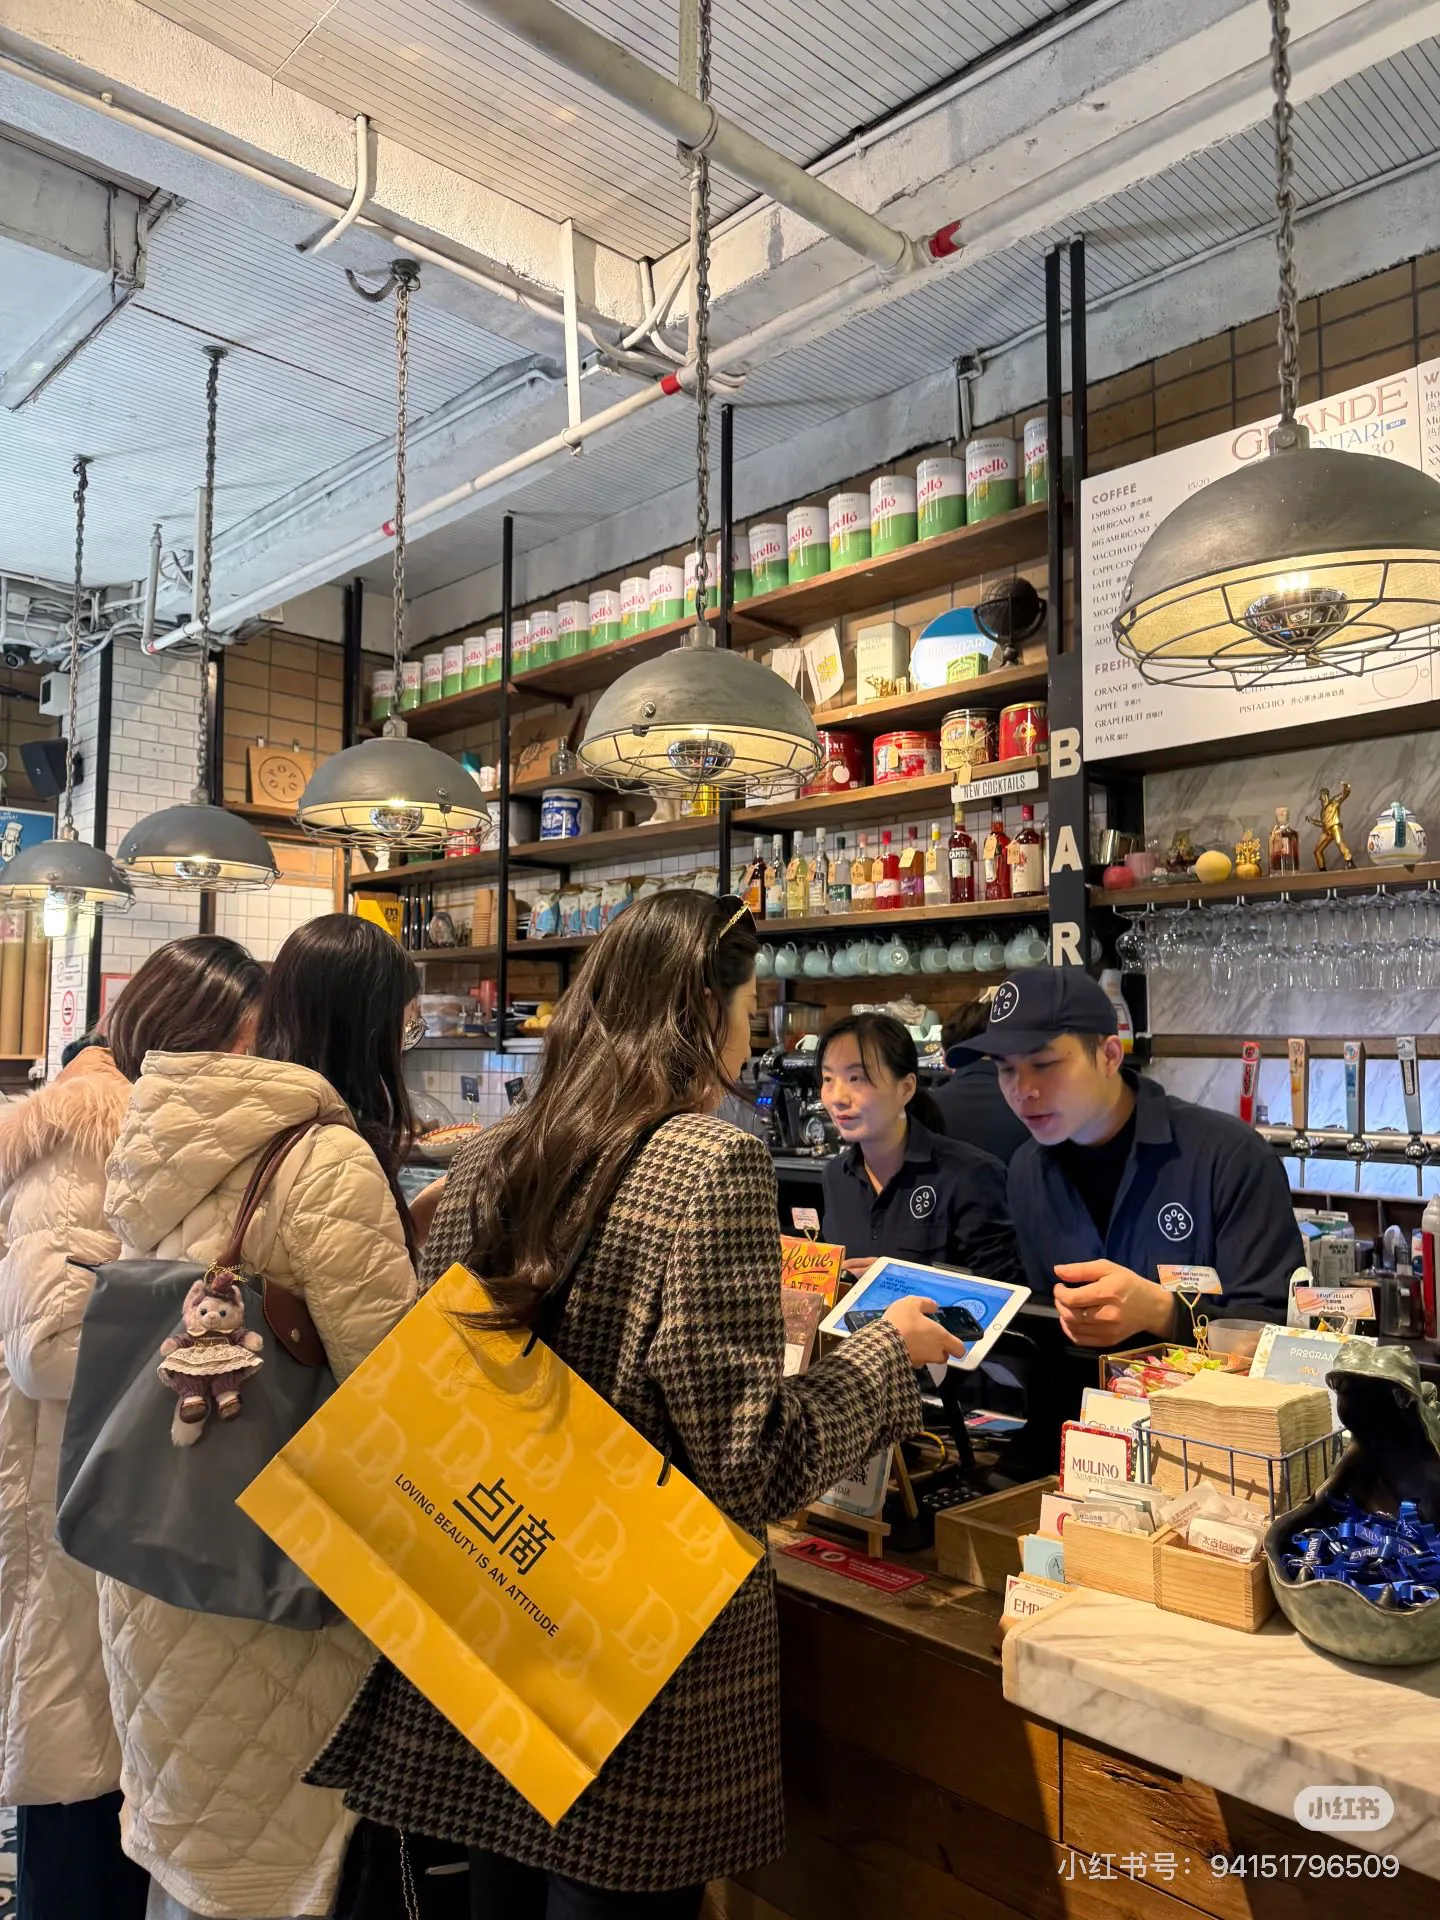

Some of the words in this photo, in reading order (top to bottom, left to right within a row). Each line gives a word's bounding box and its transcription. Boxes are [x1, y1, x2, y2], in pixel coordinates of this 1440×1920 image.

[918, 478, 943, 499] relló
[1092, 482, 1137, 505] COFFEE
[871, 496, 896, 519] relló
[1091, 503, 1127, 520] ESPRESSO
[1091, 515, 1135, 534] AMERICANO
[1091, 537, 1105, 548] BIG
[1105, 526, 1150, 544] AMERICANO
[1092, 558, 1136, 576] CAPPUCCIN
[1093, 605, 1120, 618] MOCH
[1095, 658, 1131, 675] FRESH
[1094, 683, 1128, 697] ORANGE
[1094, 701, 1117, 713] APPLE
[1239, 699, 1285, 714] PISTACHIO
[1094, 711, 1143, 729] GRAPEFRUIT
[1095, 733, 1115, 744] PEAR
[963, 782, 980, 800] NEW
[982, 775, 1026, 797] COCKTAILS
[949, 847, 971, 860] CAMPA
[1050, 726, 1084, 968] BAR
[782, 1243, 834, 1275] Leone
[1072, 1456, 1119, 1479] MULINO
[394, 1473, 436, 1516] LOVING
[433, 1511, 478, 1556] BEAUTY
[475, 1553, 490, 1569] IS
[487, 1567, 507, 1586] AN
[505, 1584, 560, 1637] ATTITUDE
[1013, 1597, 1044, 1616] EMP
